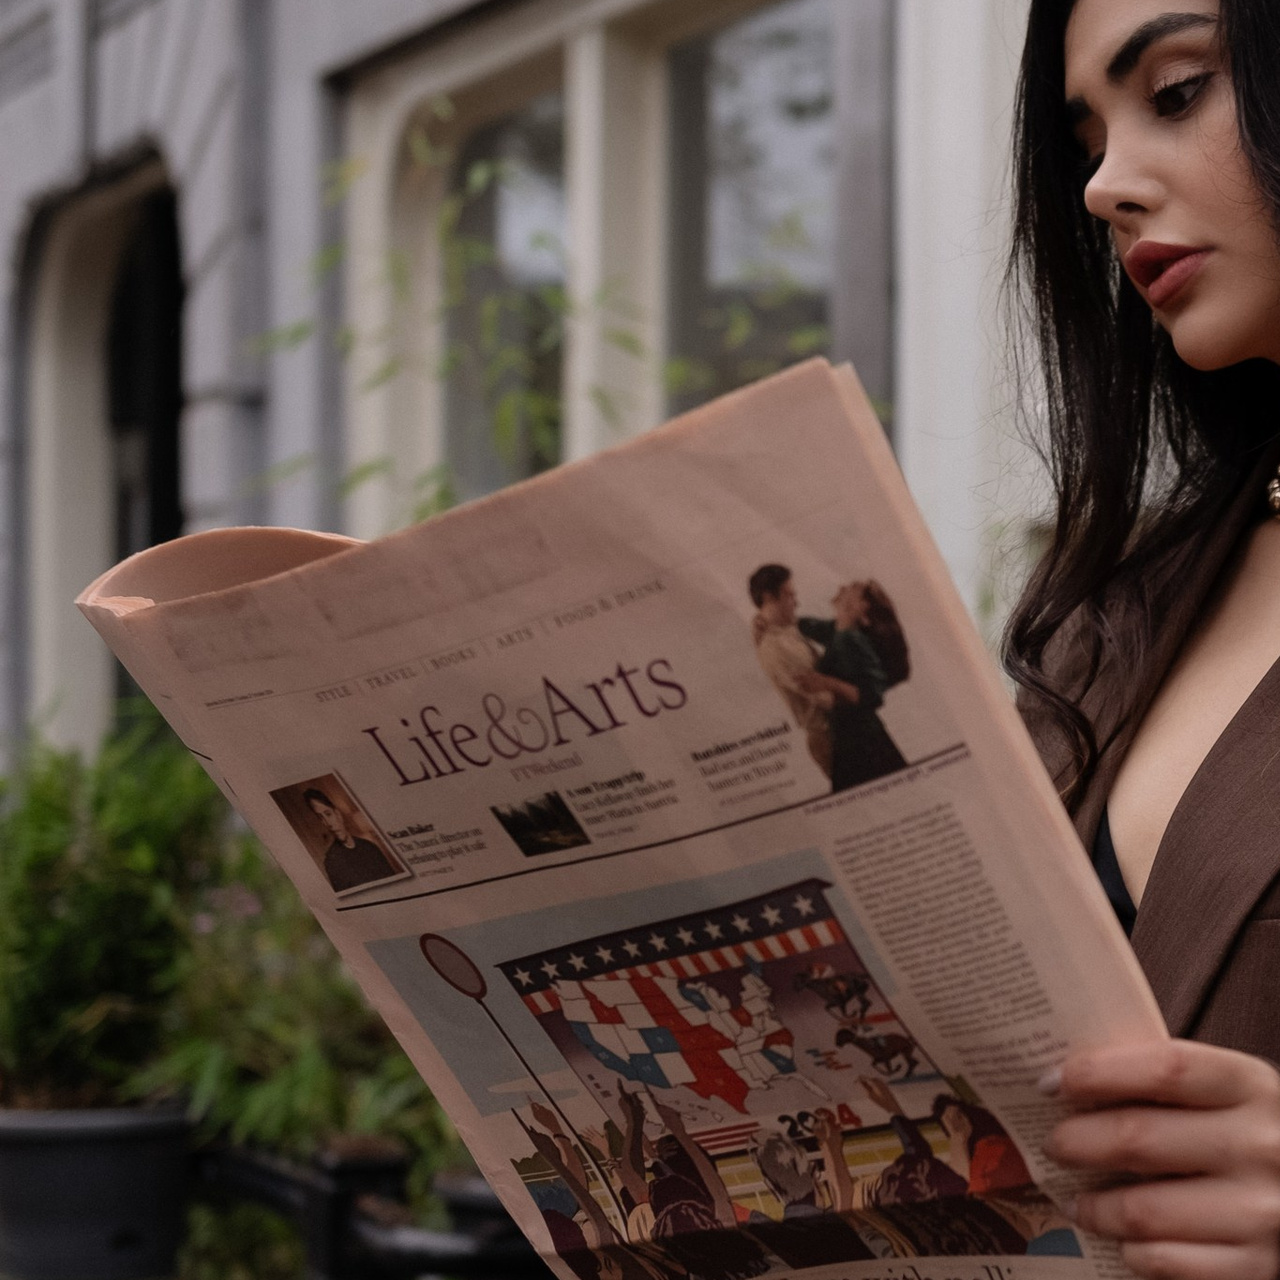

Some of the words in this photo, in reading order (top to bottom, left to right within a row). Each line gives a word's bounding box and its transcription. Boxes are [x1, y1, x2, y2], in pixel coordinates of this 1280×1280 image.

[315, 685, 352, 703] STYLE
[365, 666, 418, 690] TRAVEL
[429, 647, 476, 670] BOOKS
[497, 627, 534, 649] ARTS
[553, 602, 597, 628] FOOD
[598, 598, 613, 613] &
[615, 579, 667, 606] DRINK
[777, 1103, 863, 1138] 204
